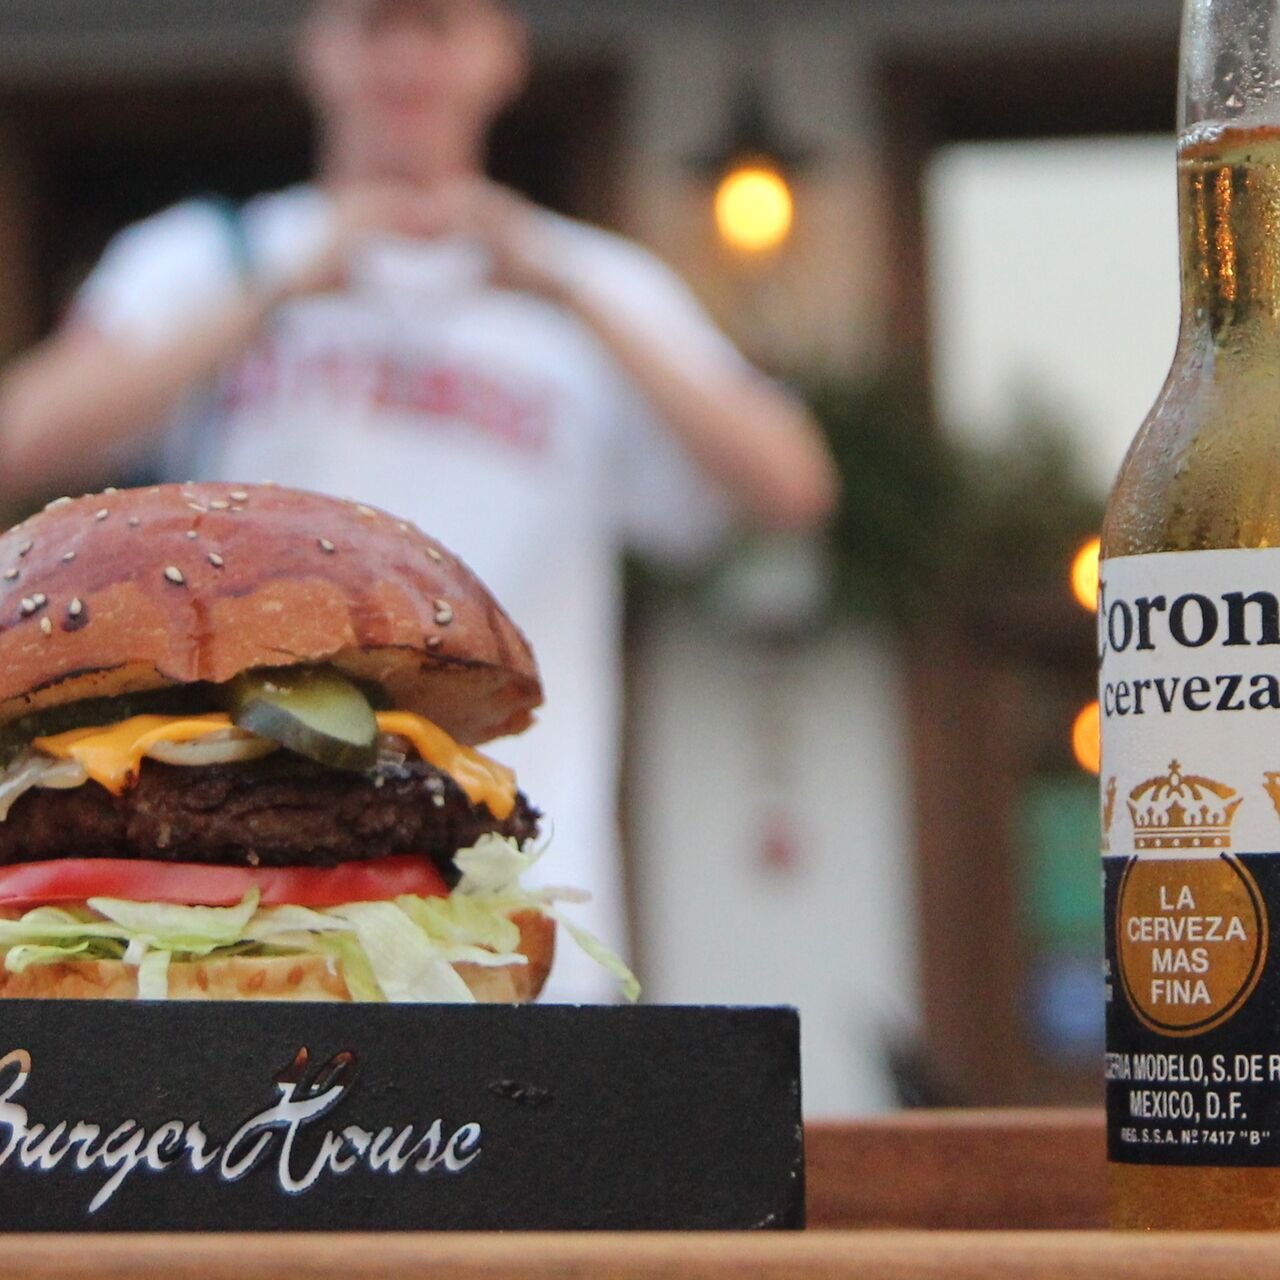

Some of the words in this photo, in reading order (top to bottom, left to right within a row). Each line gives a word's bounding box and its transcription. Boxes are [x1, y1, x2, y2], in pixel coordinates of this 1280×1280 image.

[1159, 884, 1196, 911] LA
[1126, 915, 1248, 943] CERVEZA
[1151, 947, 1210, 974] MAS
[1150, 978, 1212, 1006] FINA
[1133, 1053, 1209, 1086] MODELO,
[1129, 1089, 1200, 1123] MEXICO,
[1206, 1090, 1247, 1120] D.F.
[221, 1045, 482, 1196] House
[1202, 1129, 1236, 1145] 7417
